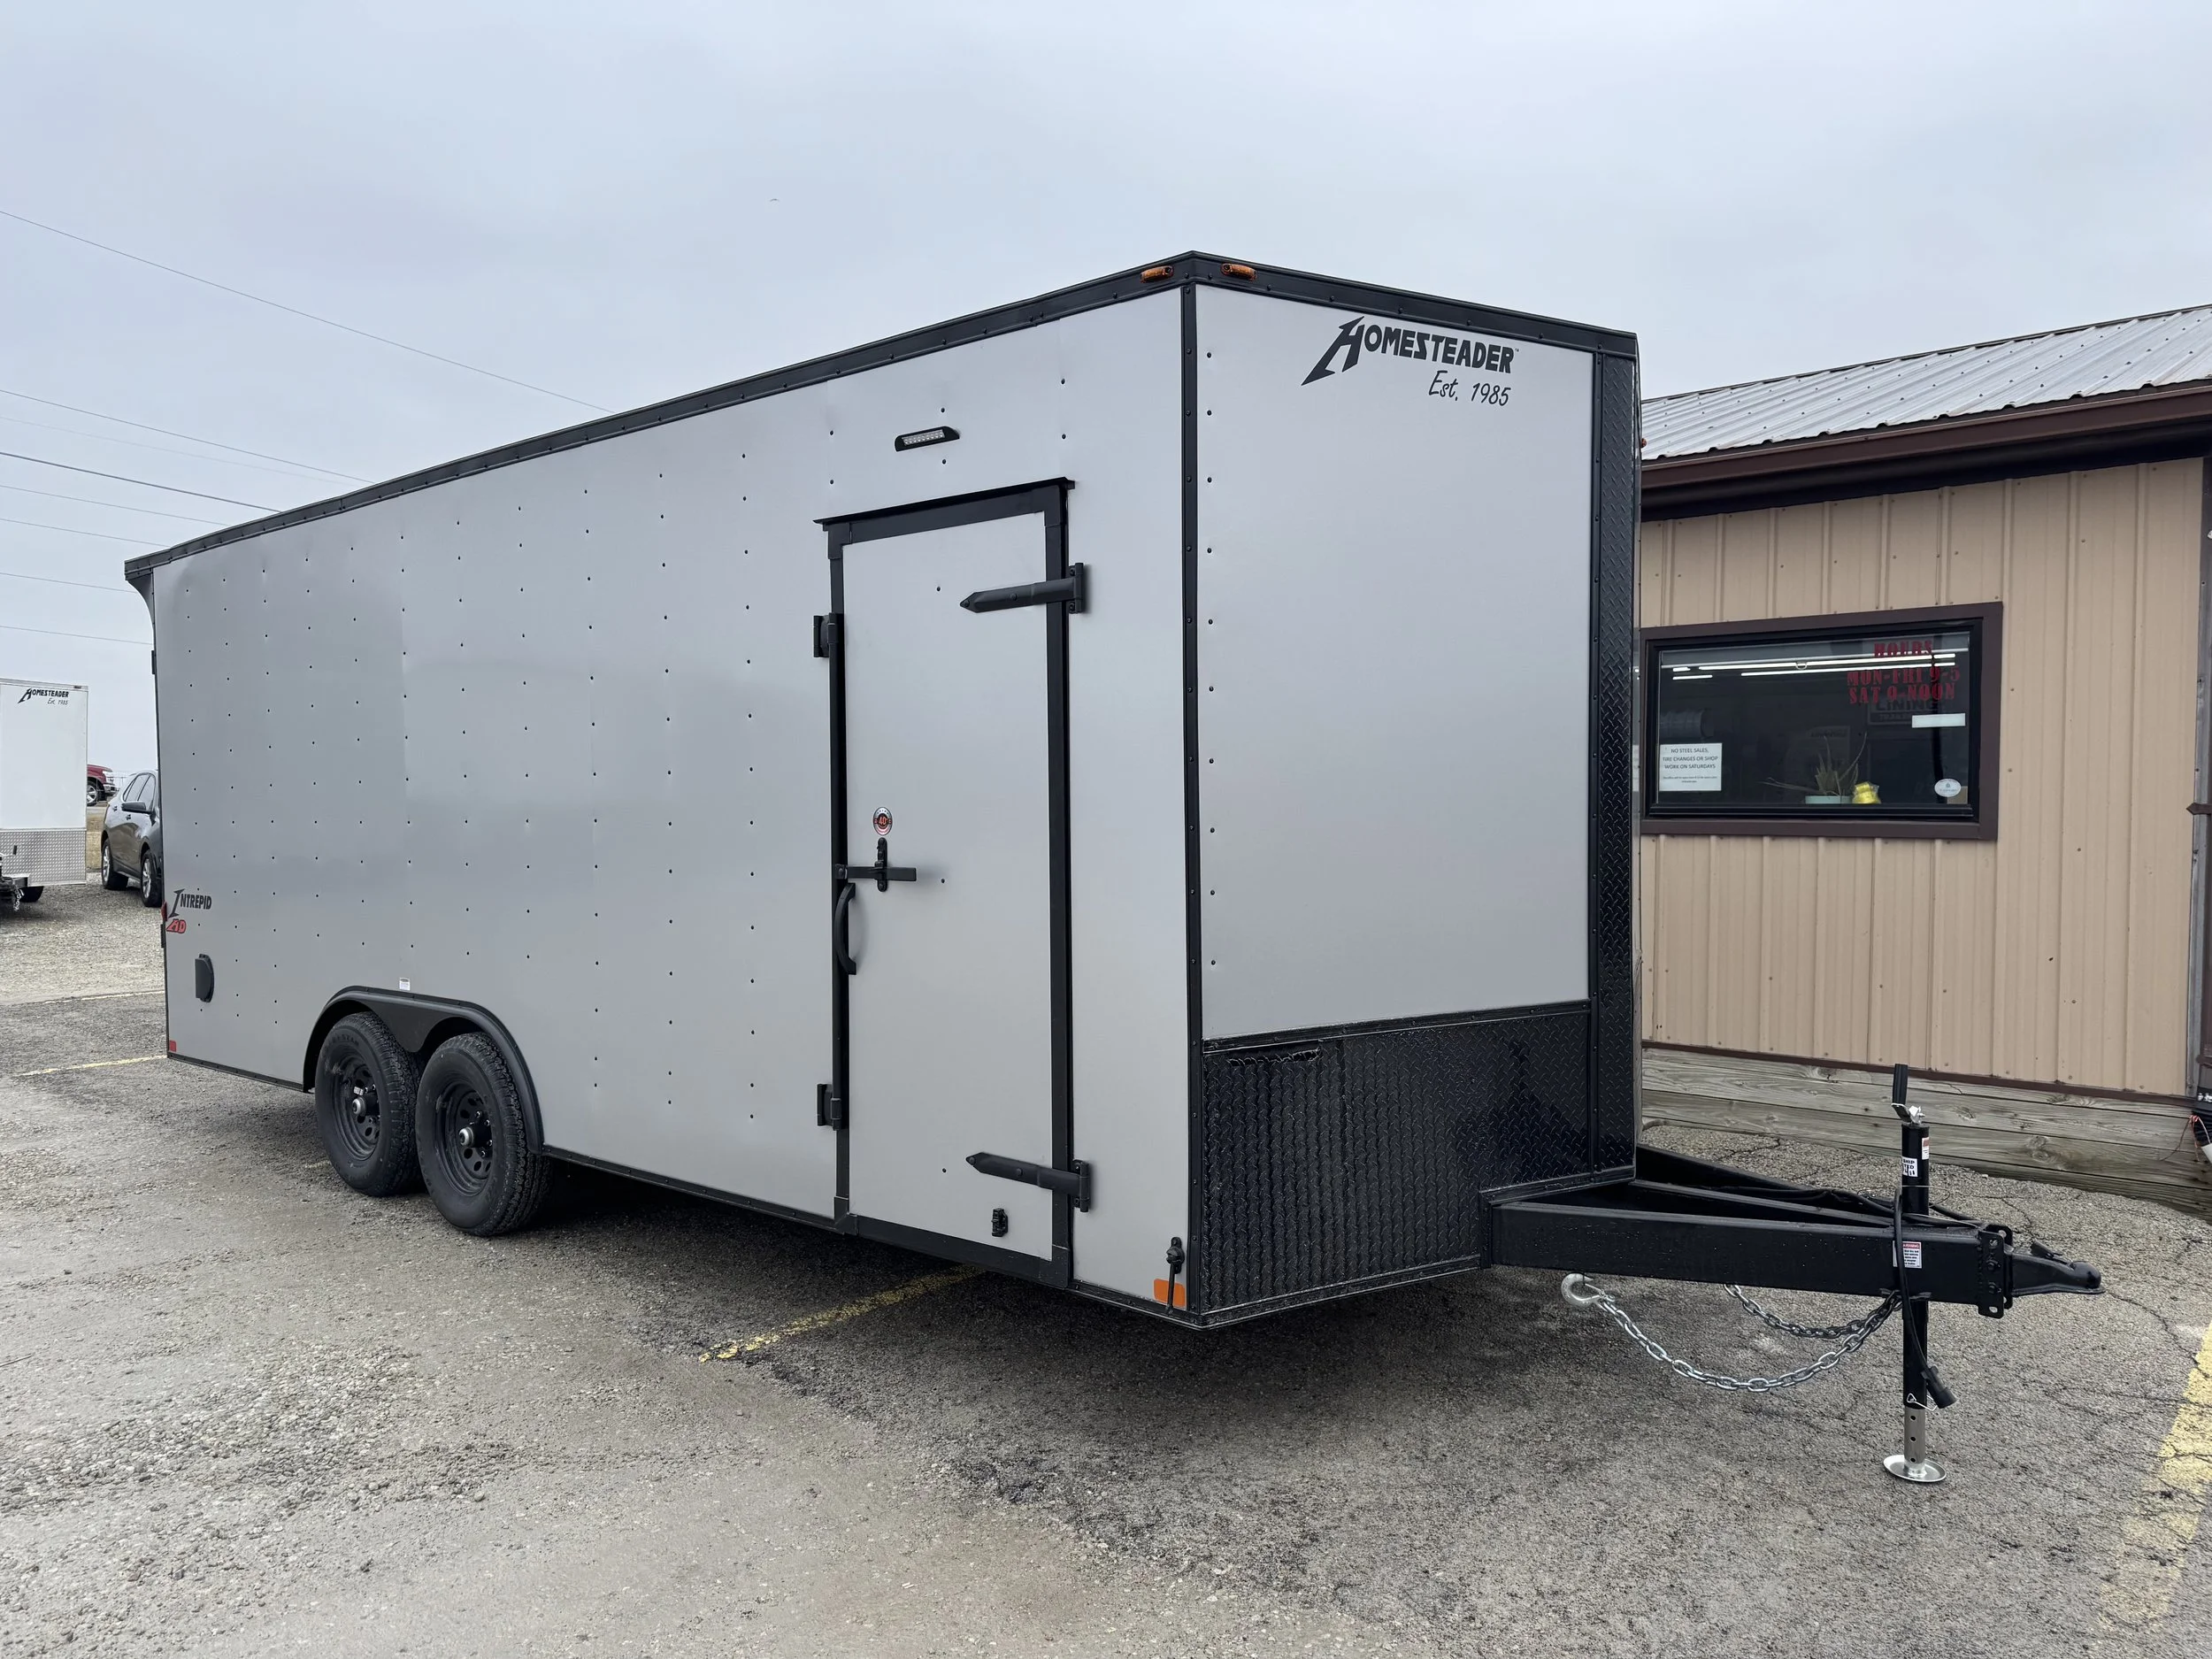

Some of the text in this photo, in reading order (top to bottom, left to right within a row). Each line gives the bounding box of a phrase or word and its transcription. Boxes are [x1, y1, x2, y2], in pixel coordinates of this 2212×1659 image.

[1301, 316, 1515, 386] HOMESTEADER
[1428, 370, 1511, 406] Est. 1985
[18, 687, 69, 703] HOMESTEADER
[1849, 687, 1879, 704] SAT
[168, 888, 212, 918] INTREPID
